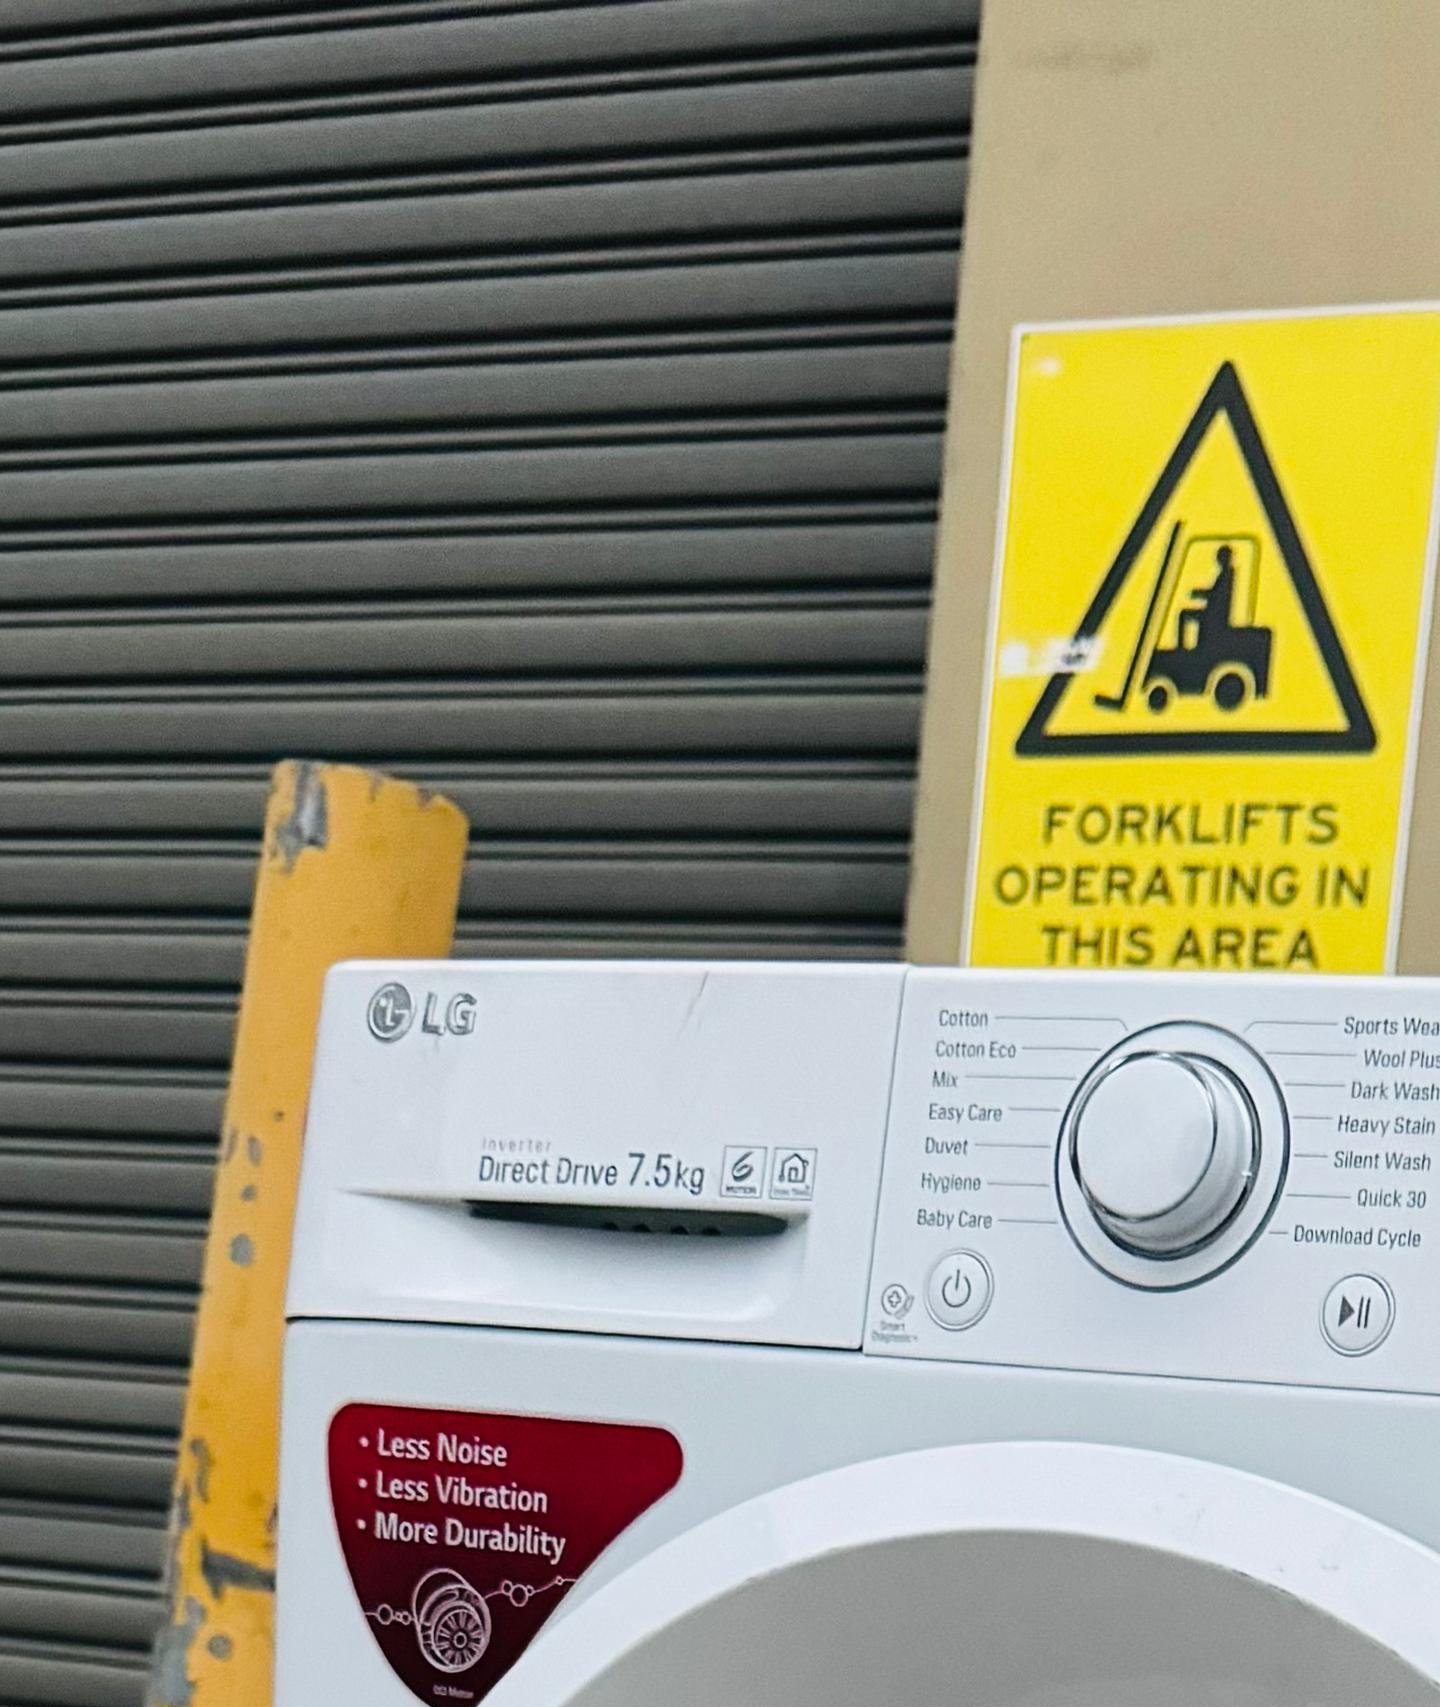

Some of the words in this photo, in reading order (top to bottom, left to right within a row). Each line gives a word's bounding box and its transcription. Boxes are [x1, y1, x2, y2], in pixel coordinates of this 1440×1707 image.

[1042, 802, 1339, 846] FORKLIFTS
[994, 864, 1300, 907] OPERATING
[1317, 864, 1370, 909] IN
[1042, 926, 1154, 967] THIS
[1169, 927, 1319, 969] AREA
[422, 992, 477, 1036] LG
[938, 1009, 989, 1027] Cotton
[1344, 1016, 1398, 1038] Sports
[935, 1040, 984, 1058] Cotton
[988, 1041, 1016, 1058] Eco
[1363, 1050, 1405, 1068] Wool
[932, 1071, 959, 1088] Mix
[1351, 1082, 1389, 1100] Dark
[1393, 1083, 1440, 1101] Wash
[928, 1103, 963, 1124] Easy
[967, 1104, 1003, 1121] Care
[1338, 1116, 1389, 1137] Heavy
[1394, 1116, 1436, 1134] Stain
[925, 1138, 968, 1155] Duvet
[1333, 1151, 1380, 1169] Silent
[1383, 1153, 1431, 1171] Wash
[480, 1155, 550, 1186] Direct
[557, 1157, 618, 1187] Drive
[627, 1152, 704, 1196] 7.5kg
[921, 1172, 981, 1194] Hygiene
[1357, 1190, 1401, 1208] Quick
[1405, 1190, 1427, 1209] 30
[917, 1210, 955, 1232] Baby
[958, 1211, 993, 1229] Care
[1293, 1226, 1371, 1246] Download
[1376, 1228, 1421, 1249] Cycle
[376, 1428, 430, 1461] Less
[437, 1432, 508, 1467] Noise
[375, 1470, 428, 1502] Less
[435, 1474, 548, 1513] Vibration
[373, 1511, 438, 1545] More
[444, 1517, 566, 1566] Durability
